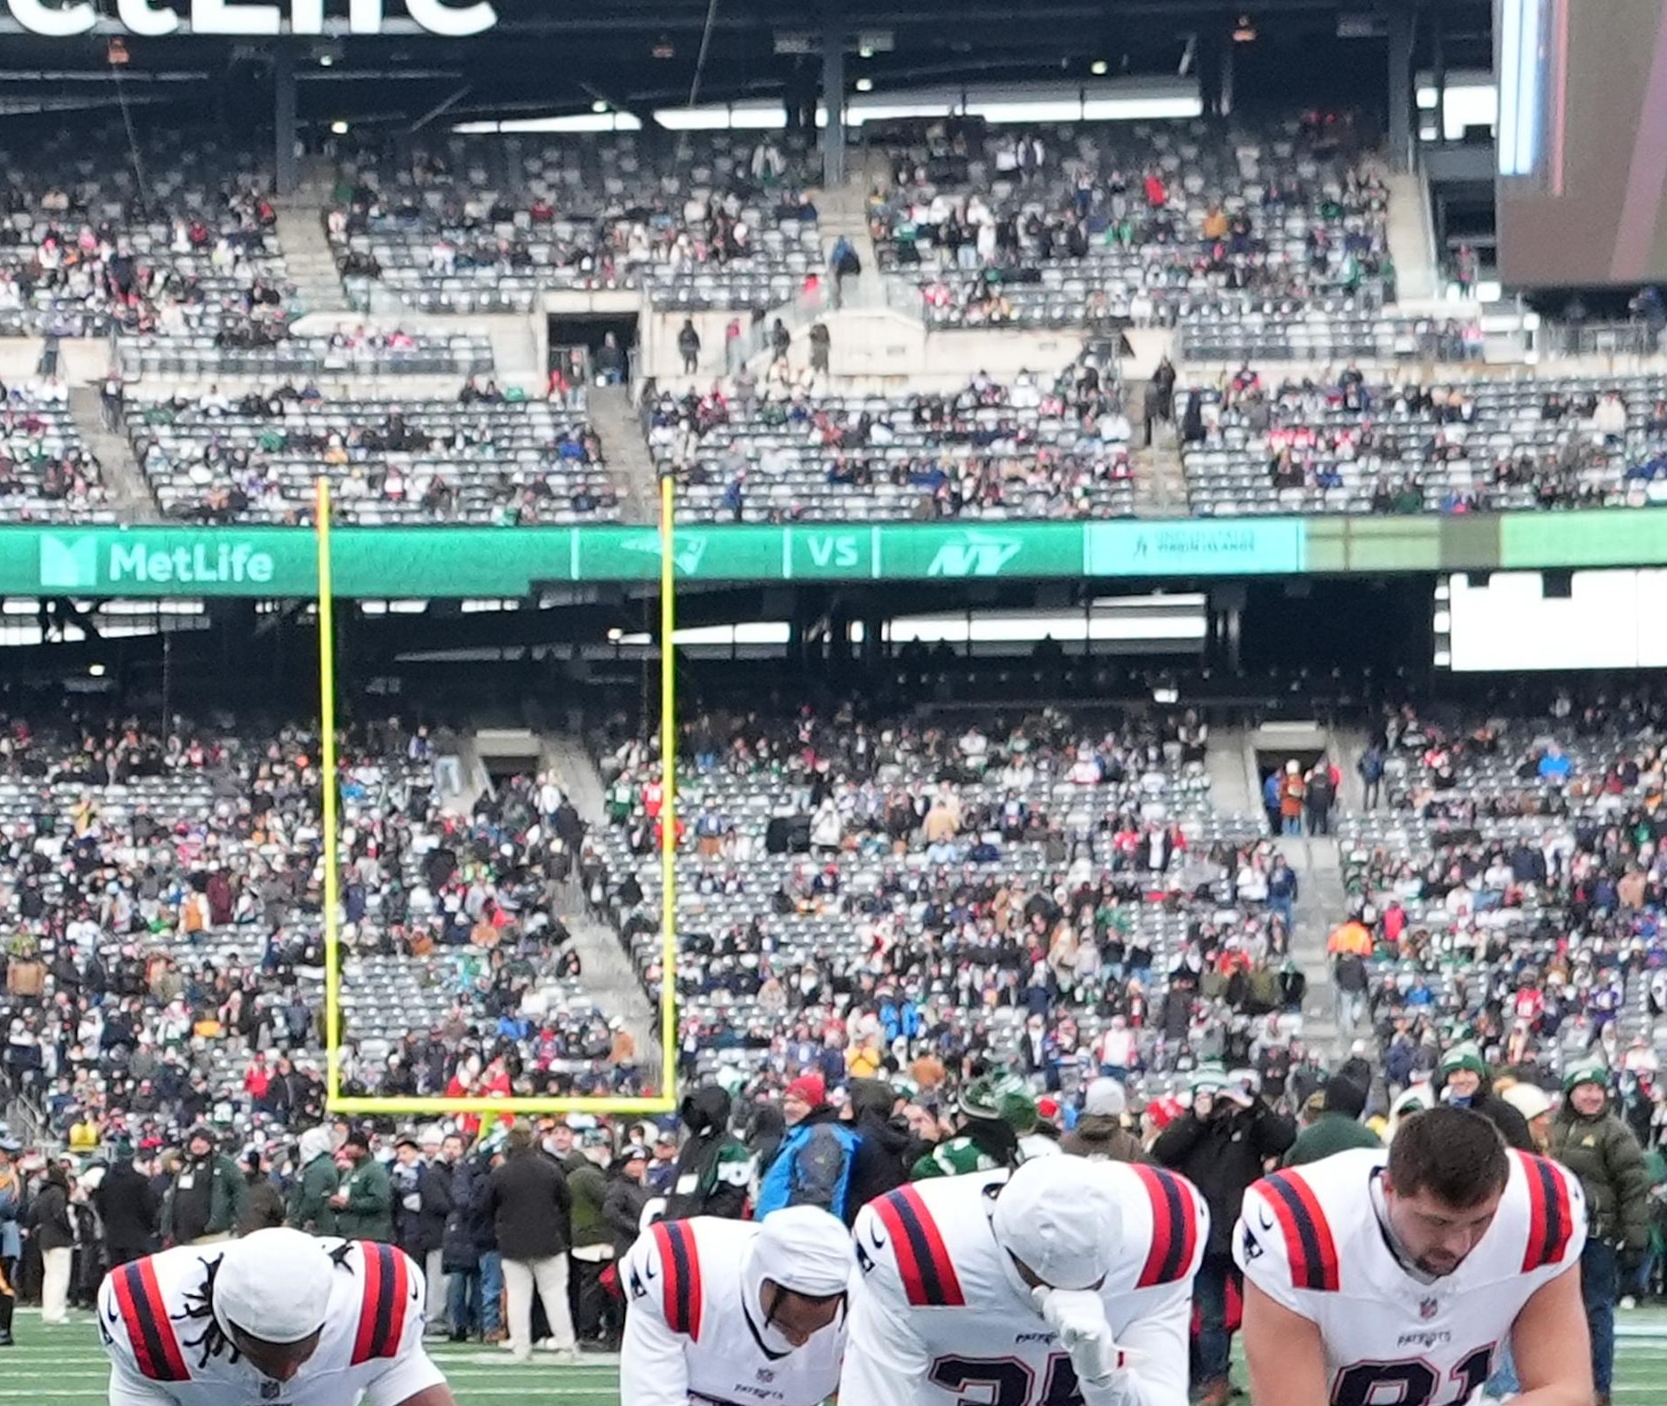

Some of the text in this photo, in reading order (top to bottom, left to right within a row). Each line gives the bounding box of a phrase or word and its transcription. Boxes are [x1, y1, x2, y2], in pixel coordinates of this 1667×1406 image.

[109, 542, 273, 583] MetLife
[808, 536, 858, 567] VS
[1398, 1331, 1451, 1347] PATRIOTS
